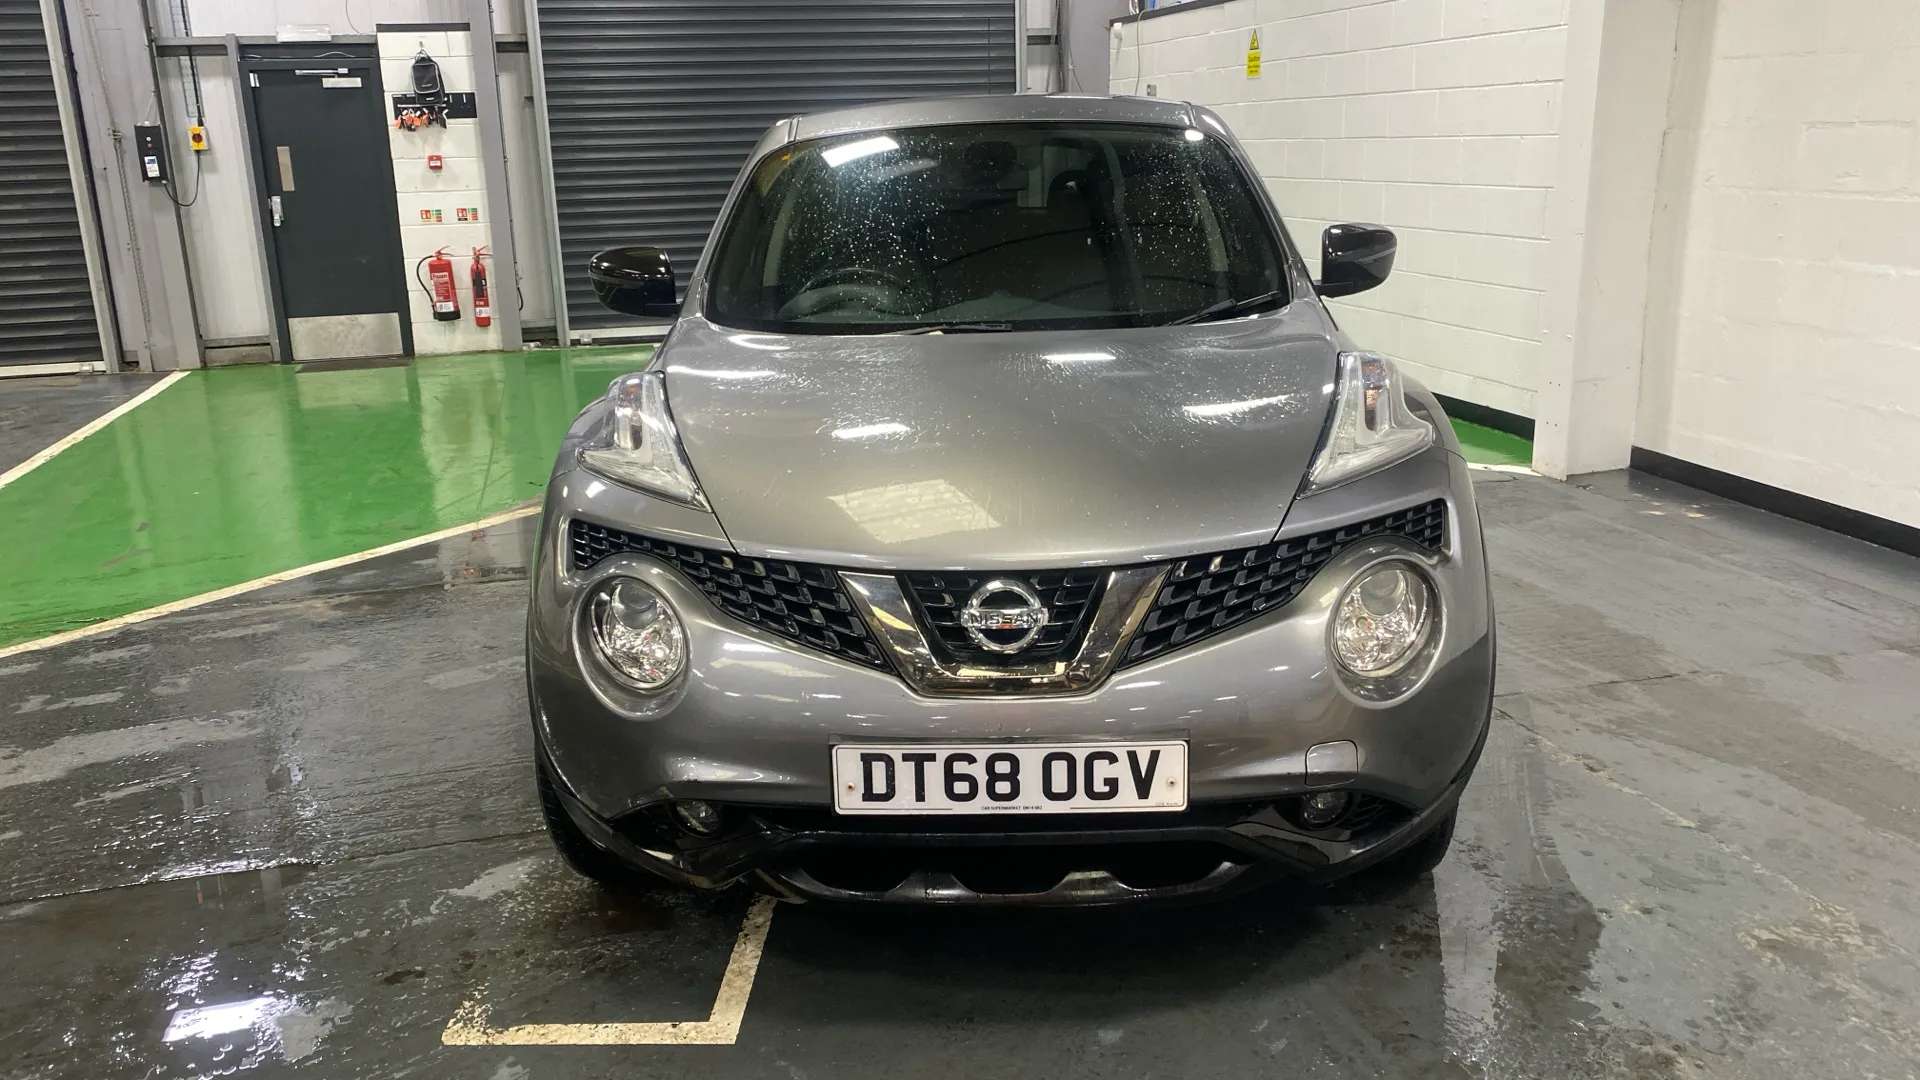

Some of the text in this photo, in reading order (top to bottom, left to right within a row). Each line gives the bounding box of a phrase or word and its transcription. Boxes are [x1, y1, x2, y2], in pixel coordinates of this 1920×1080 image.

[971, 611, 1039, 626] NISSAN
[861, 750, 1160, 803] DT68 OGV
